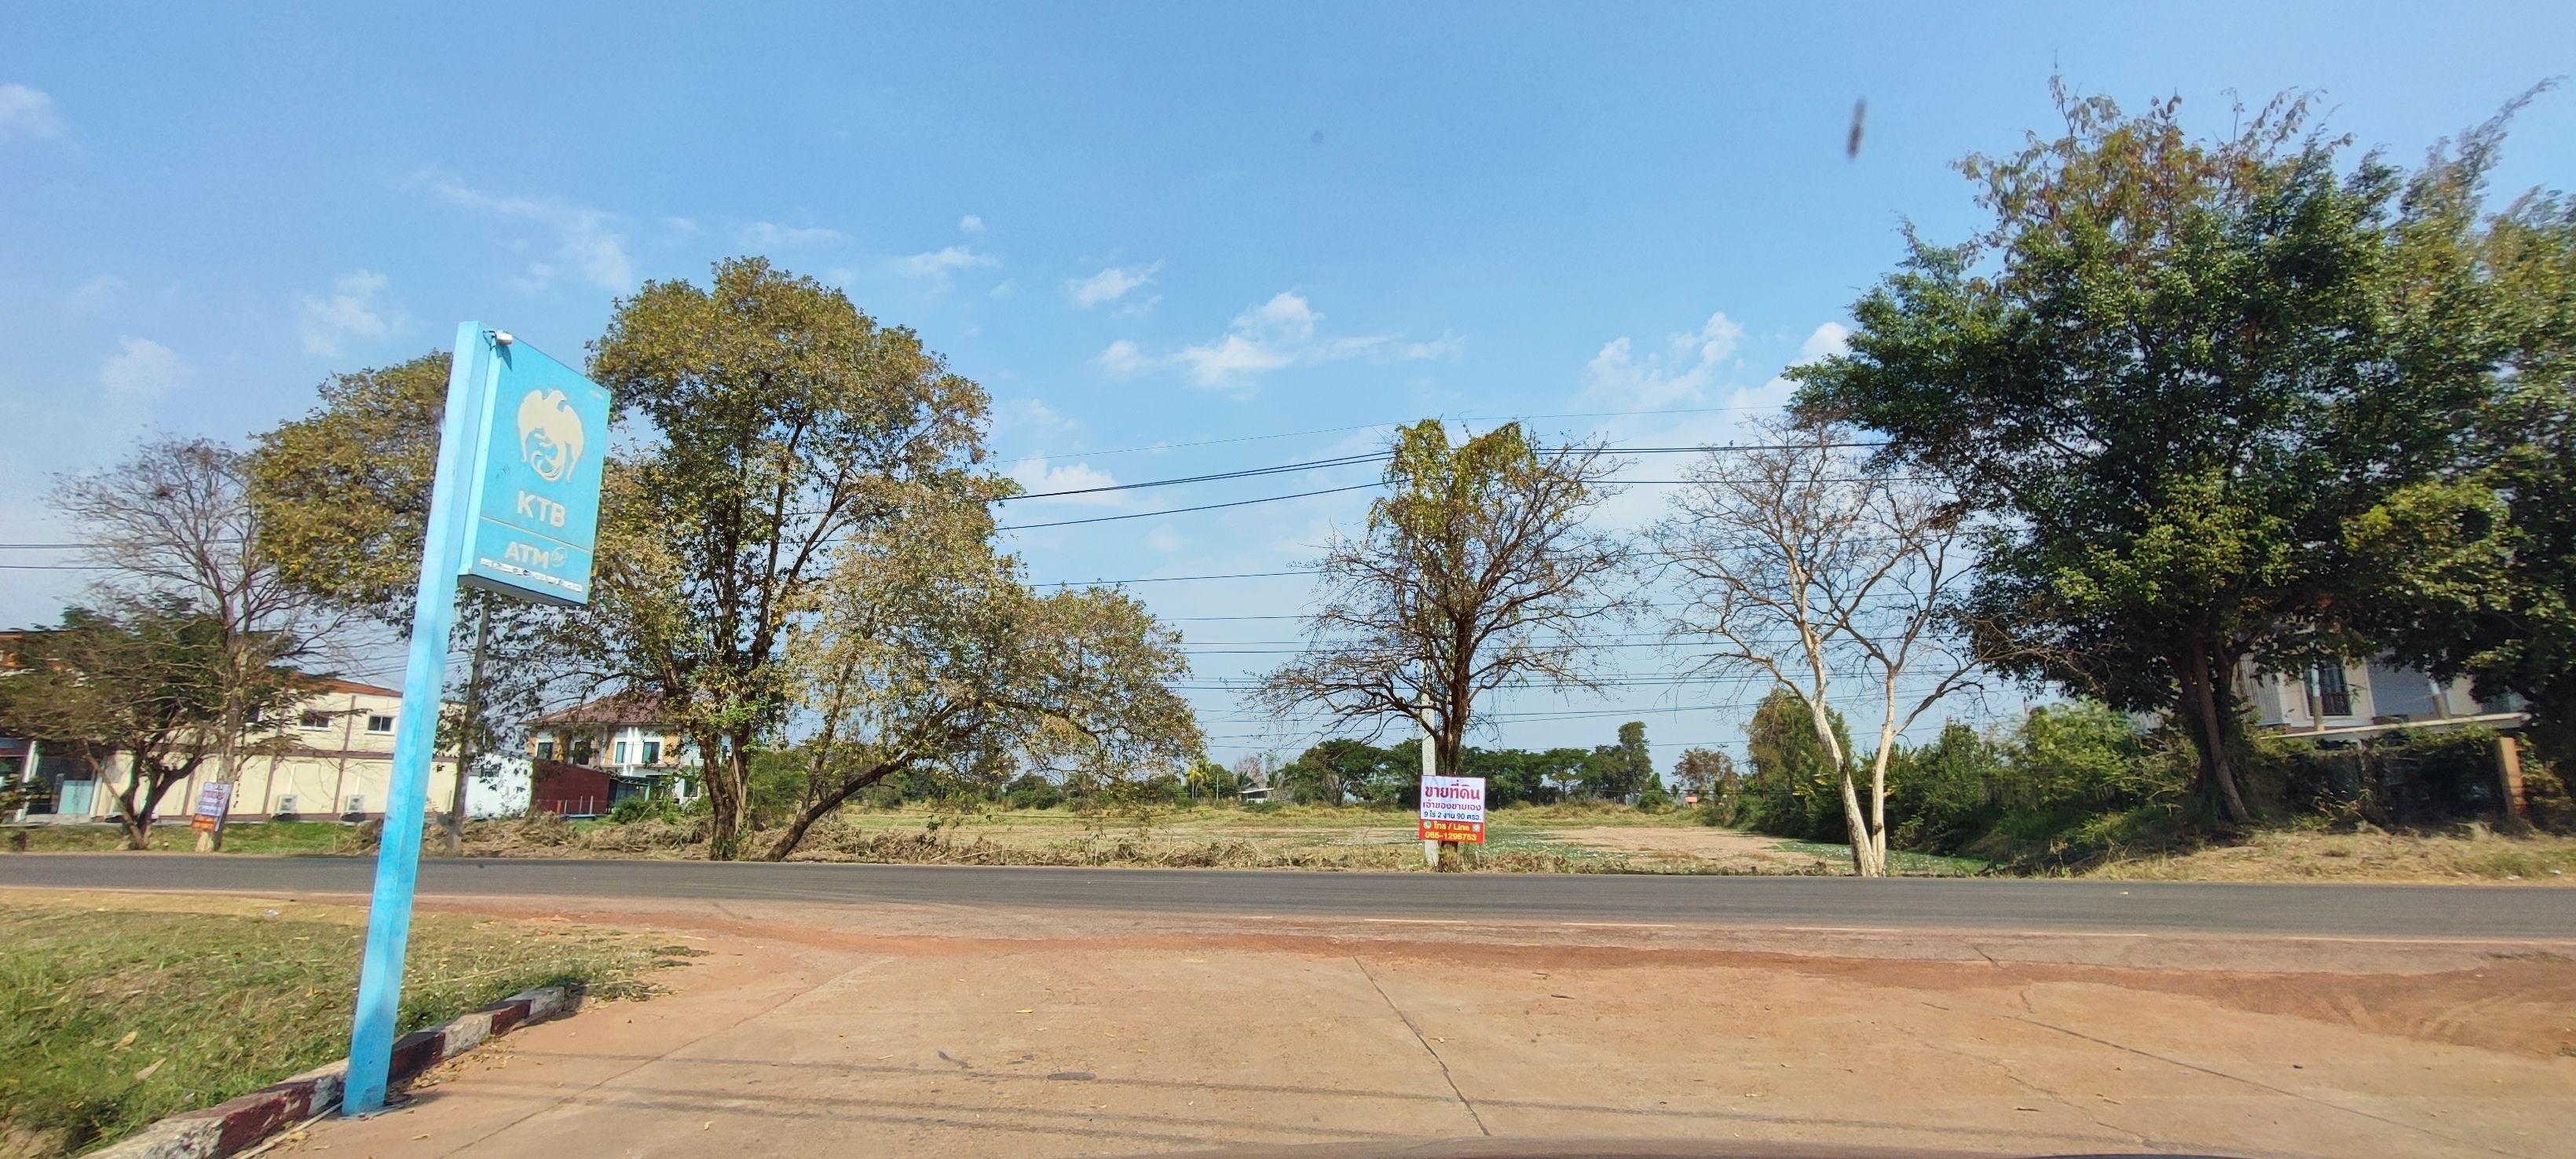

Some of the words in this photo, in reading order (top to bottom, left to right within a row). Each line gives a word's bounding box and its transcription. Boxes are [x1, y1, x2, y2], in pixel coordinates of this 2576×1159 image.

[516, 490, 566, 528] KTB
[504, 541, 549, 569] ATM
[1425, 780, 1480, 799] ขายที่ดิน
[1423, 799, 1481, 810] เจ้าของขายเอง
[1433, 821, 1447, 830] โทร
